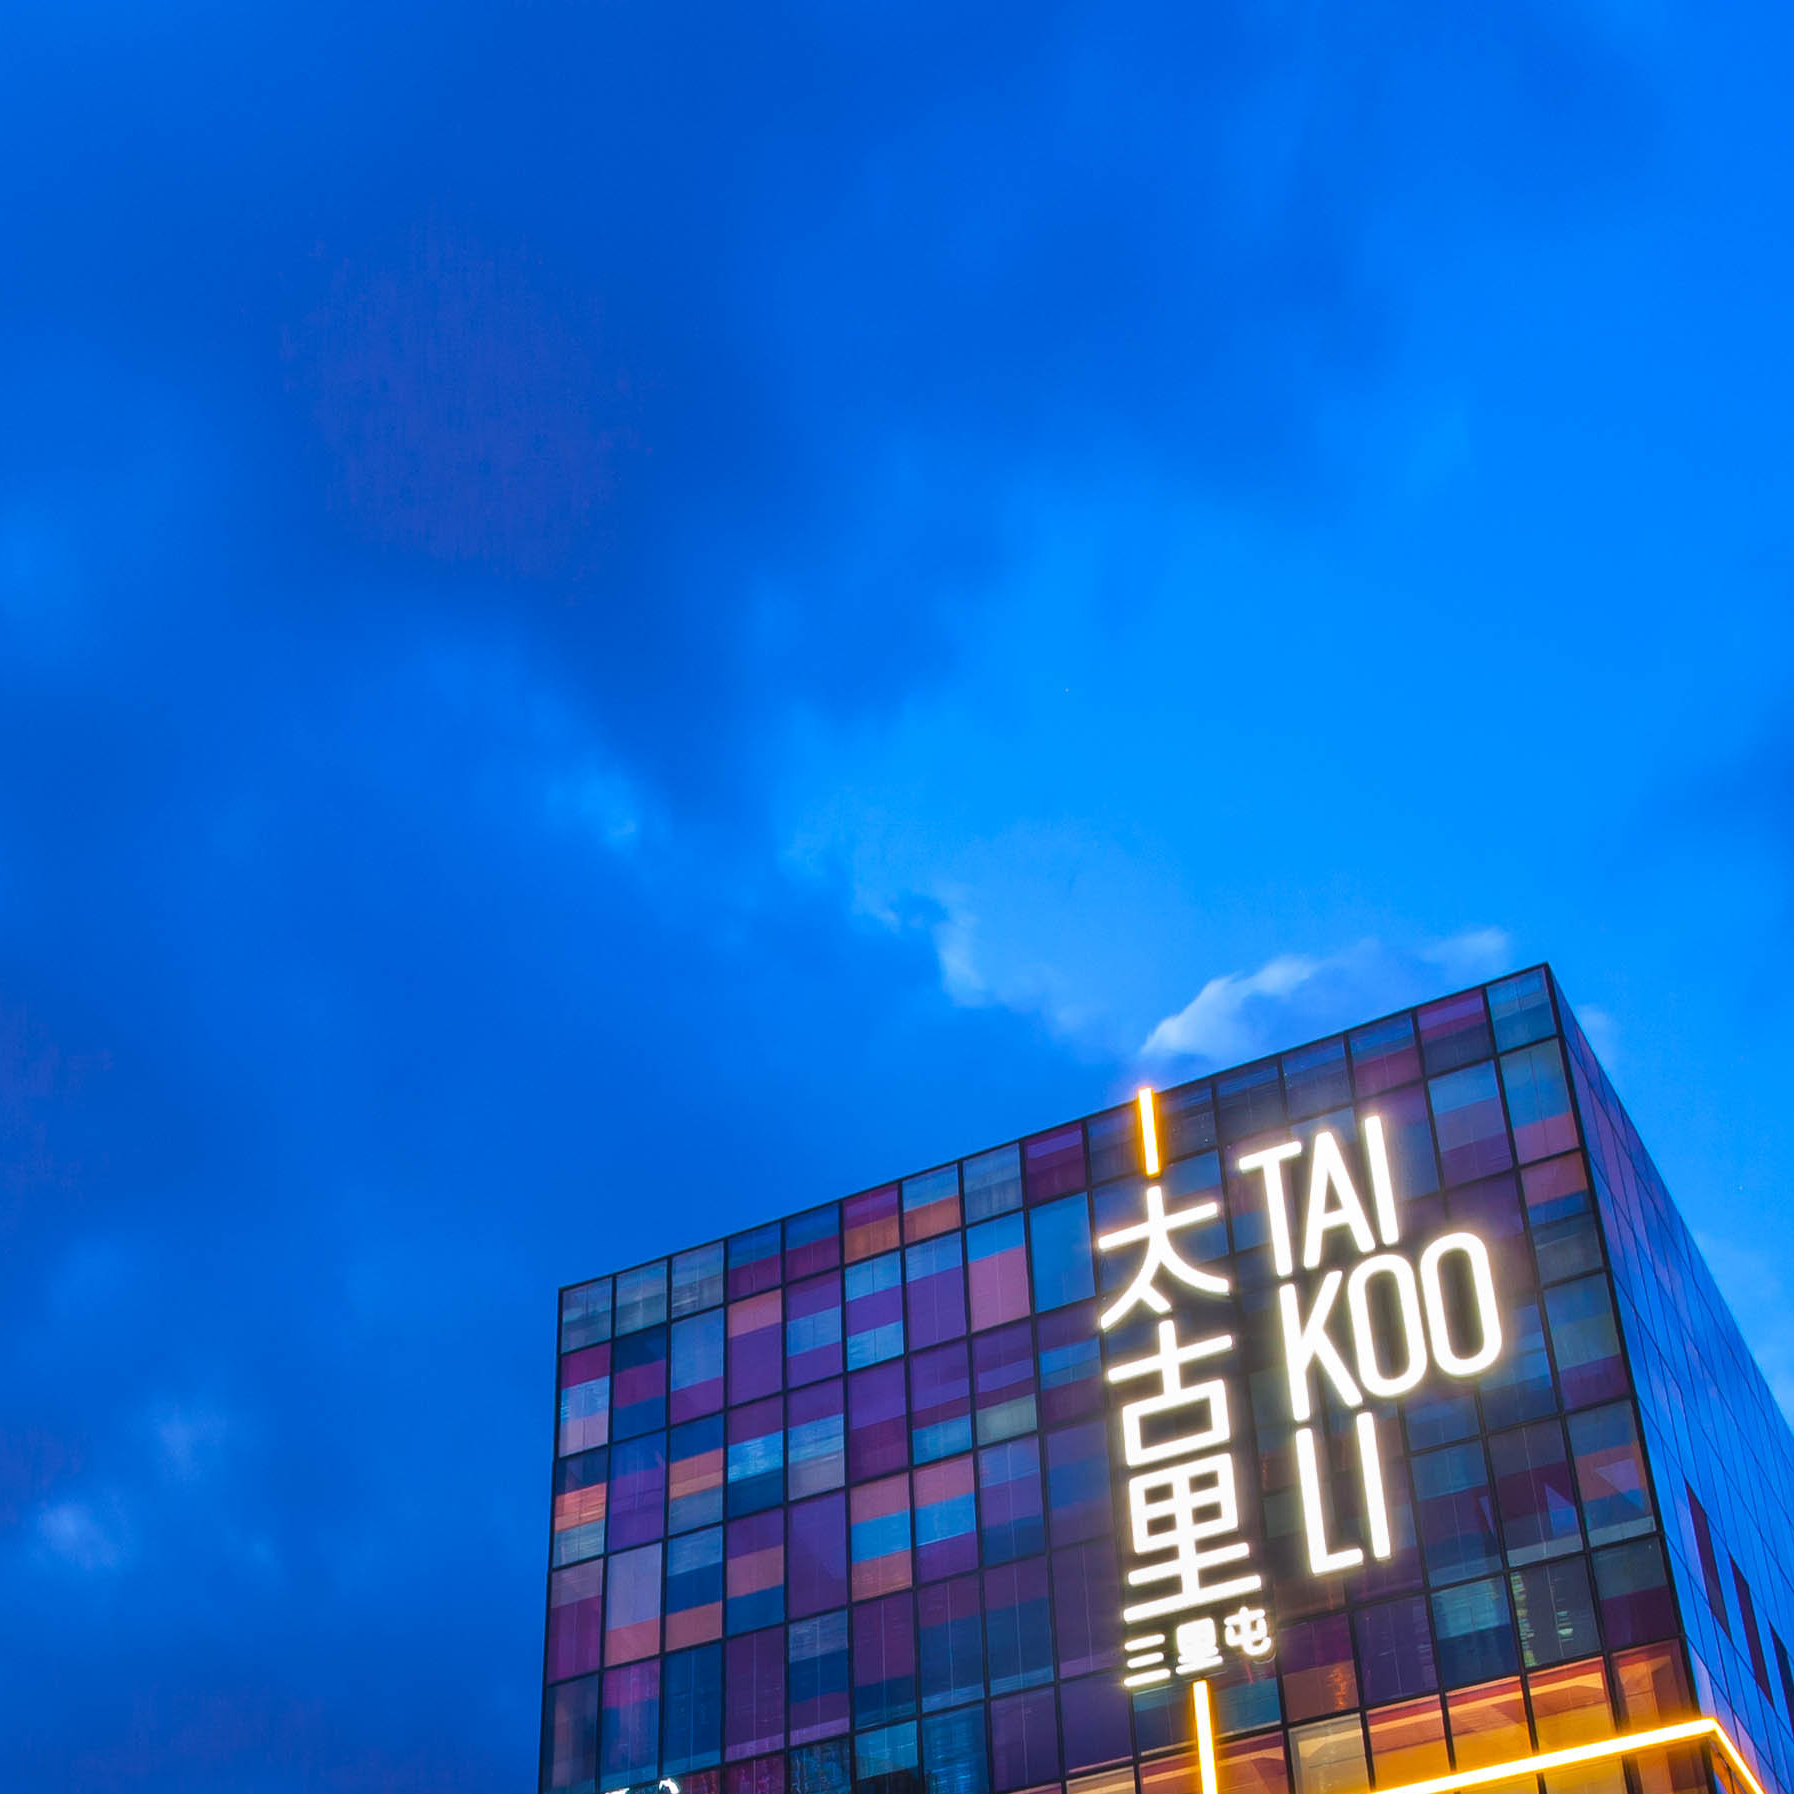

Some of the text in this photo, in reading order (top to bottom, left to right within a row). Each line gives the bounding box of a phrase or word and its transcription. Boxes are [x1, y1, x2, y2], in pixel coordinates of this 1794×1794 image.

[1238, 1114, 1402, 1277] TAI
[1099, 1186, 1263, 1625] 太古里
[1278, 1231, 1504, 1422] KOO
[1296, 1411, 1392, 1576] LI
[1122, 1606, 1274, 1688] 三里屯
